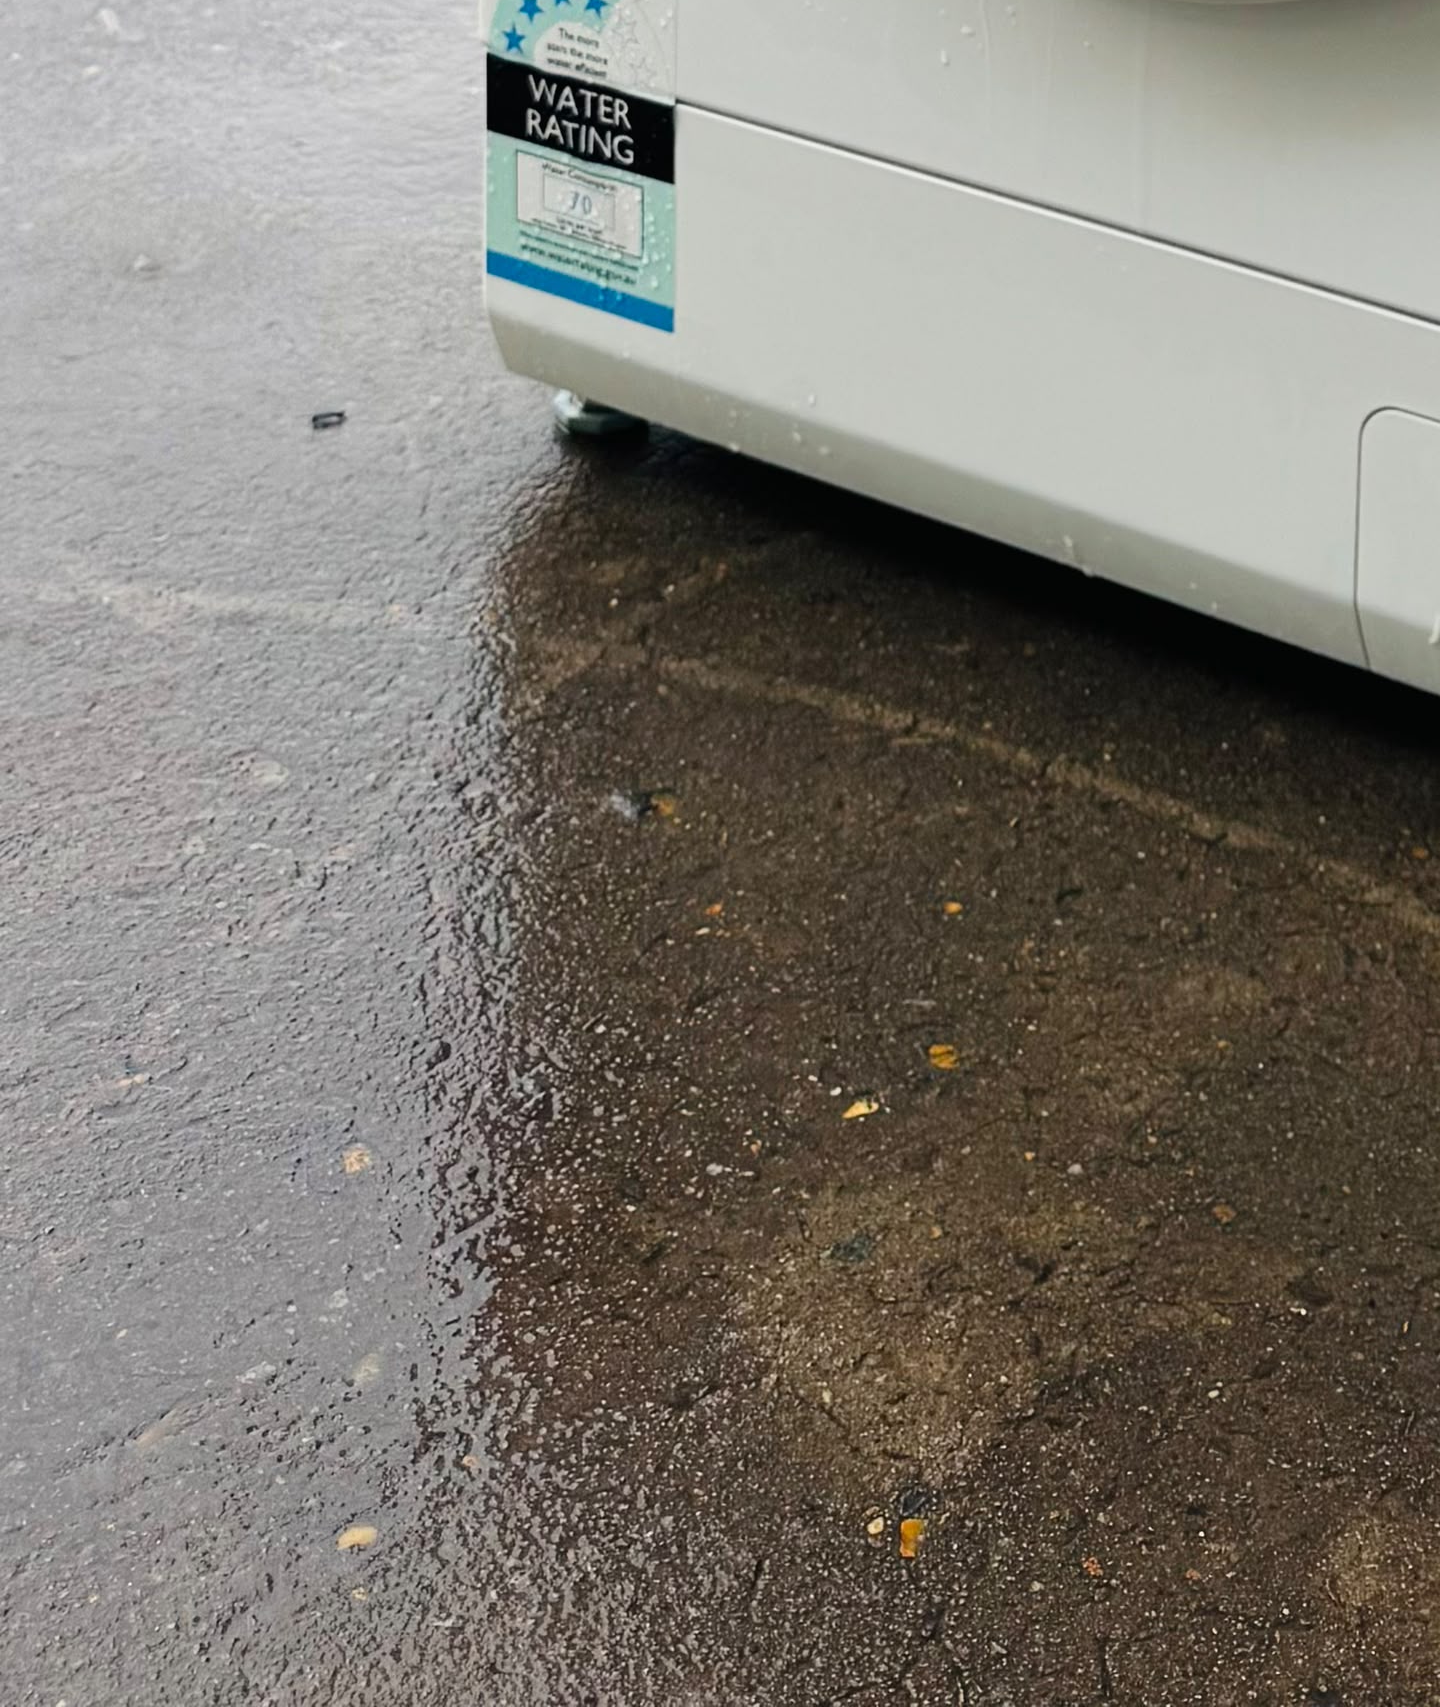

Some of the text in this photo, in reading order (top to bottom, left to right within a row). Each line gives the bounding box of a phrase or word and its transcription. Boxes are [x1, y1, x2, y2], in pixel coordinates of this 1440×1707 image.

[559, 27, 574, 41] The
[528, 74, 631, 129] WATER
[526, 108, 634, 165] RATING
